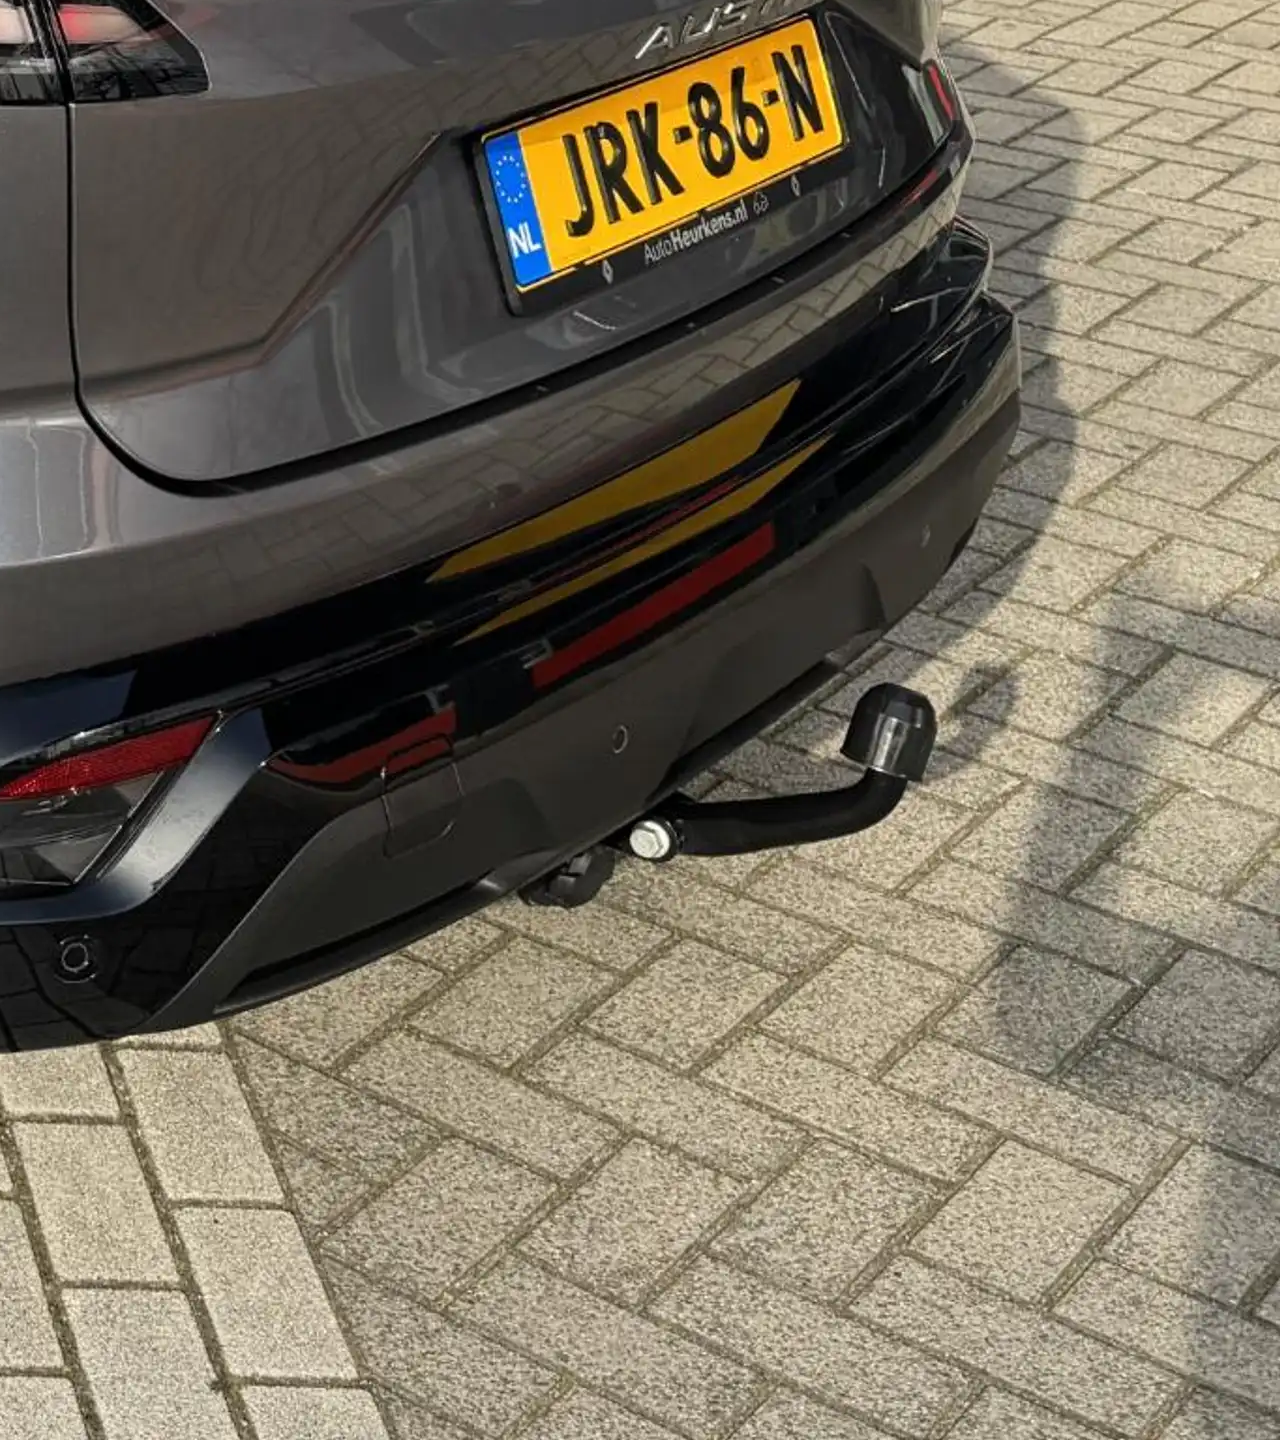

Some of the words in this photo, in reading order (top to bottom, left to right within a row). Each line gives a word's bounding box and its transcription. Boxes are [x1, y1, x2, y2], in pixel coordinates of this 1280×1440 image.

[562, 44, 825, 238] JRK-86-N
[507, 222, 542, 259] NL
[644, 197, 749, 265] AutoHeurkens.nl
